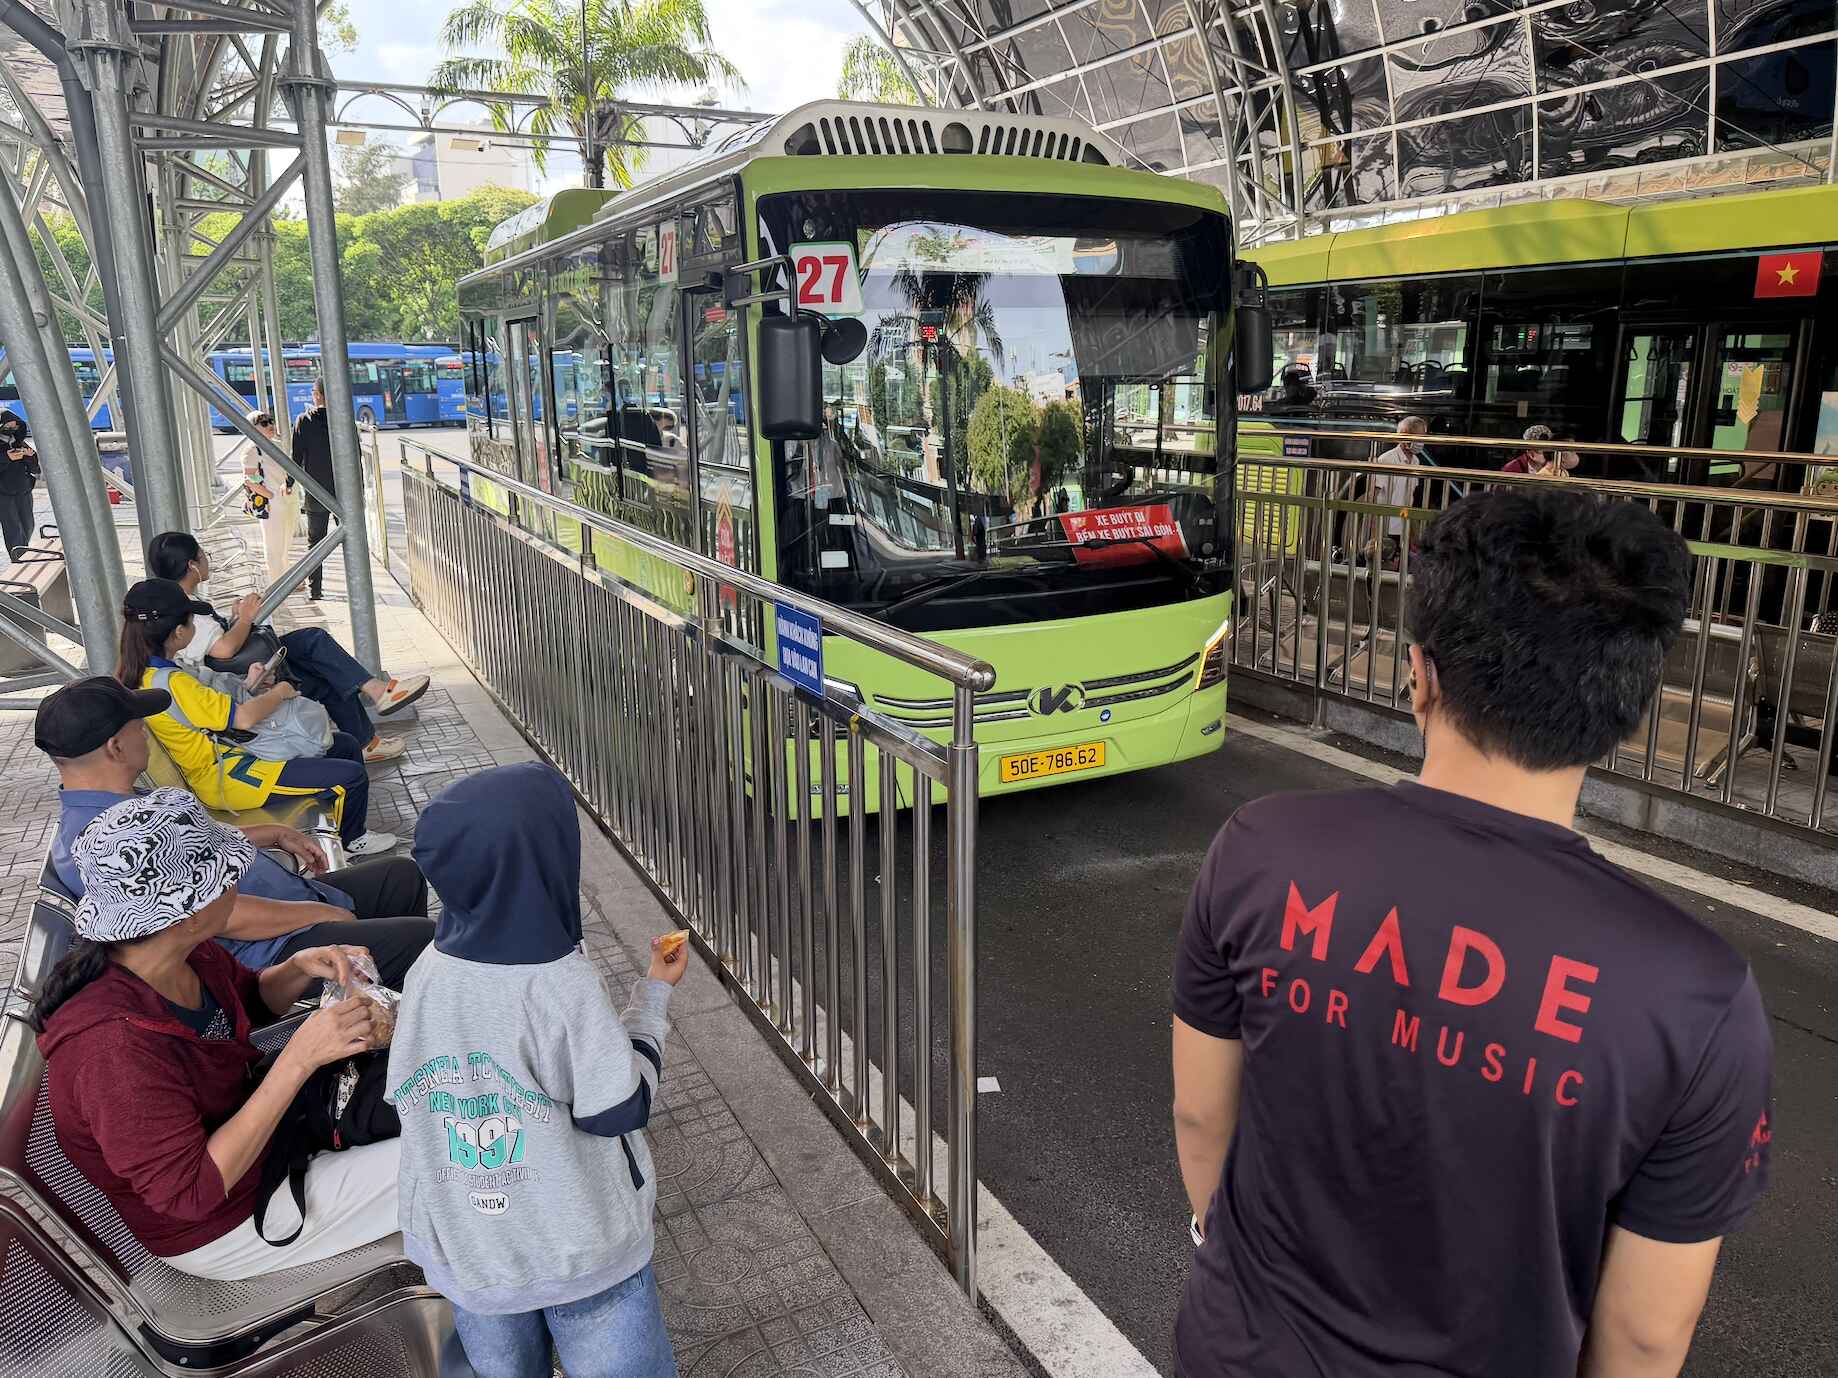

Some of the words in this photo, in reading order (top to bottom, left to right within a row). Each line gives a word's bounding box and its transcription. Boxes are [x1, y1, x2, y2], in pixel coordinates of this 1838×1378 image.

[661, 231, 674, 274] 27
[797, 255, 849, 305] 27
[1094, 513, 1109, 526] XE
[1097, 529, 1112, 540] XE
[1010, 748, 1097, 777] 50E-786.62
[1279, 879, 1599, 1044] MADE
[1260, 967, 1350, 1029] FOR
[1391, 1008, 1585, 1107] MUSIC
[457, 1091, 500, 1120] YORK
[443, 1116, 527, 1170] 1997
